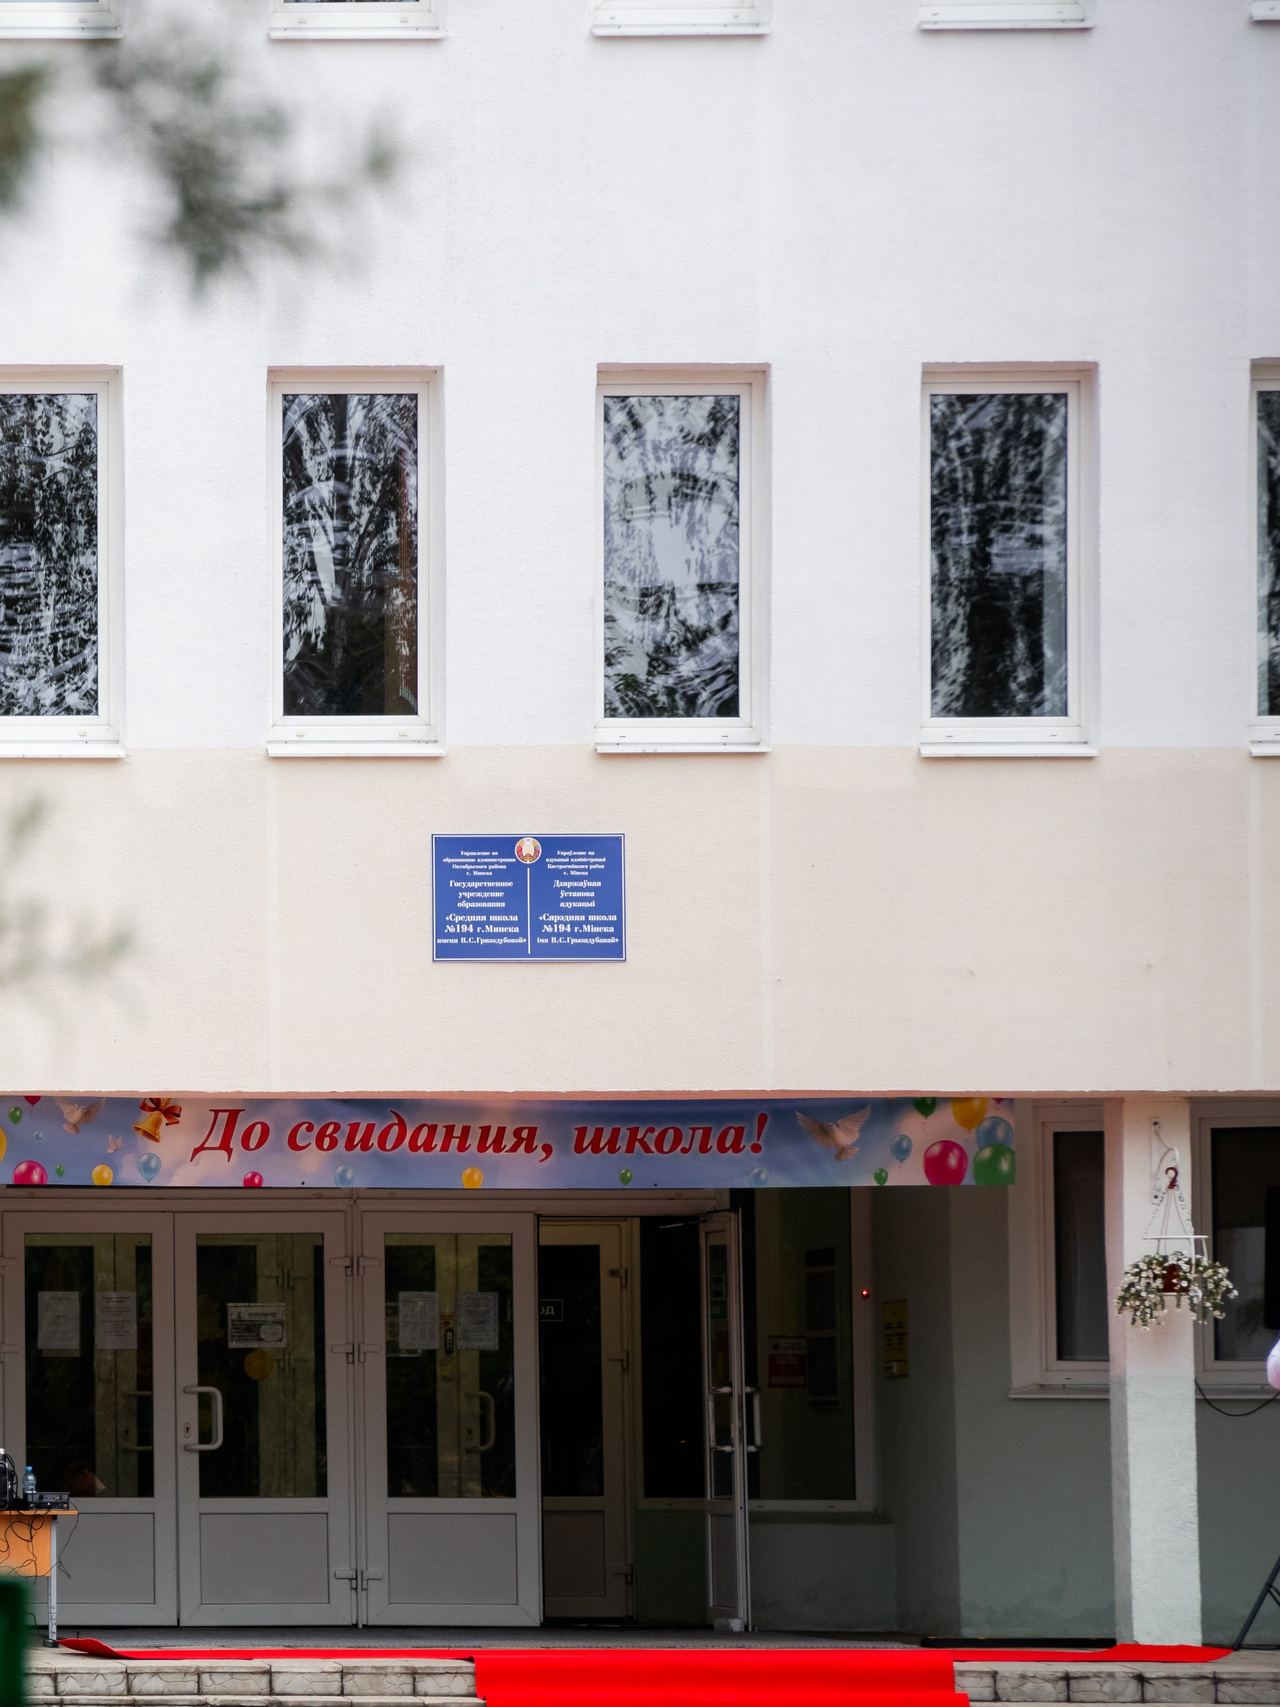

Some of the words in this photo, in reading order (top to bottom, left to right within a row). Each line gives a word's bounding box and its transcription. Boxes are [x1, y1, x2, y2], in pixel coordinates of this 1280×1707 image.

[449, 879, 514, 889] Государственное
[552, 879, 602, 889] Дзяржаўная
[458, 890, 505, 898] учреждение
[457, 900, 506, 909] образования
[559, 900, 596, 909] адукацыі
[445, 913, 487, 923] «Средняя
[444, 924, 474, 933] №194
[476, 924, 520, 933] г.Минска
[541, 923, 571, 933] №194
[190, 1108, 271, 1163] До
[287, 1109, 554, 1163] свидания,
[573, 1112, 768, 1154] школа!
